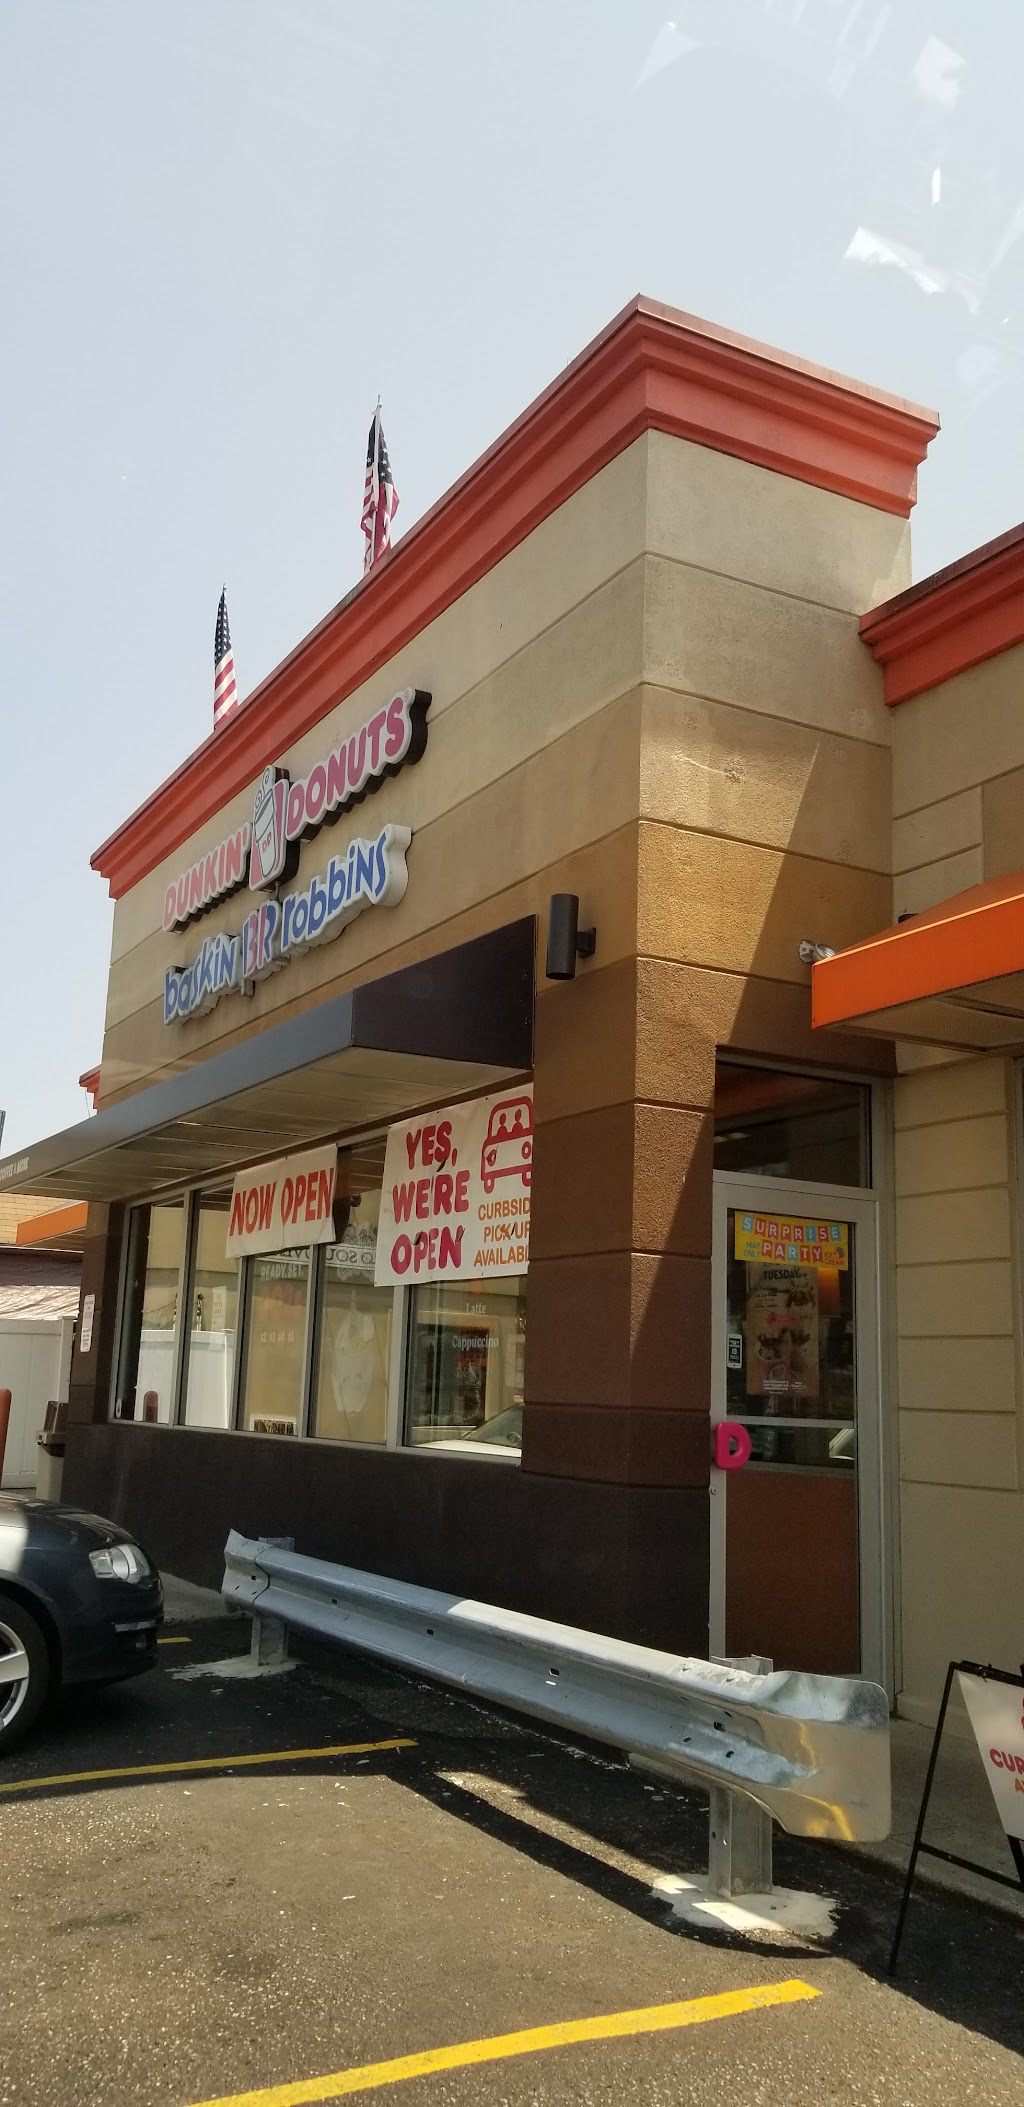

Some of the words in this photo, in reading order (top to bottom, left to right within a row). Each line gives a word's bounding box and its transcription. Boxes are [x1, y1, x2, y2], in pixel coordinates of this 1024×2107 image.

[163, 829, 248, 928] DUNKIN'
[287, 696, 405, 834] DONUTS
[243, 904, 276, 976] BR
[406, 1120, 457, 1170] YES,
[229, 1181, 277, 1238] NOW
[280, 1168, 335, 1225] OPEN
[392, 1169, 470, 1224] WE'RE
[478, 1196, 530, 1221] CURBSID
[743, 1217, 839, 1240] SURPRISE
[390, 1224, 464, 1275] OPEN
[474, 1245, 529, 1267] AVAILABL
[763, 1242, 821, 1260] PARTY
[466, 1303, 487, 1315] Latte
[452, 1335, 499, 1351] Cappuccino
